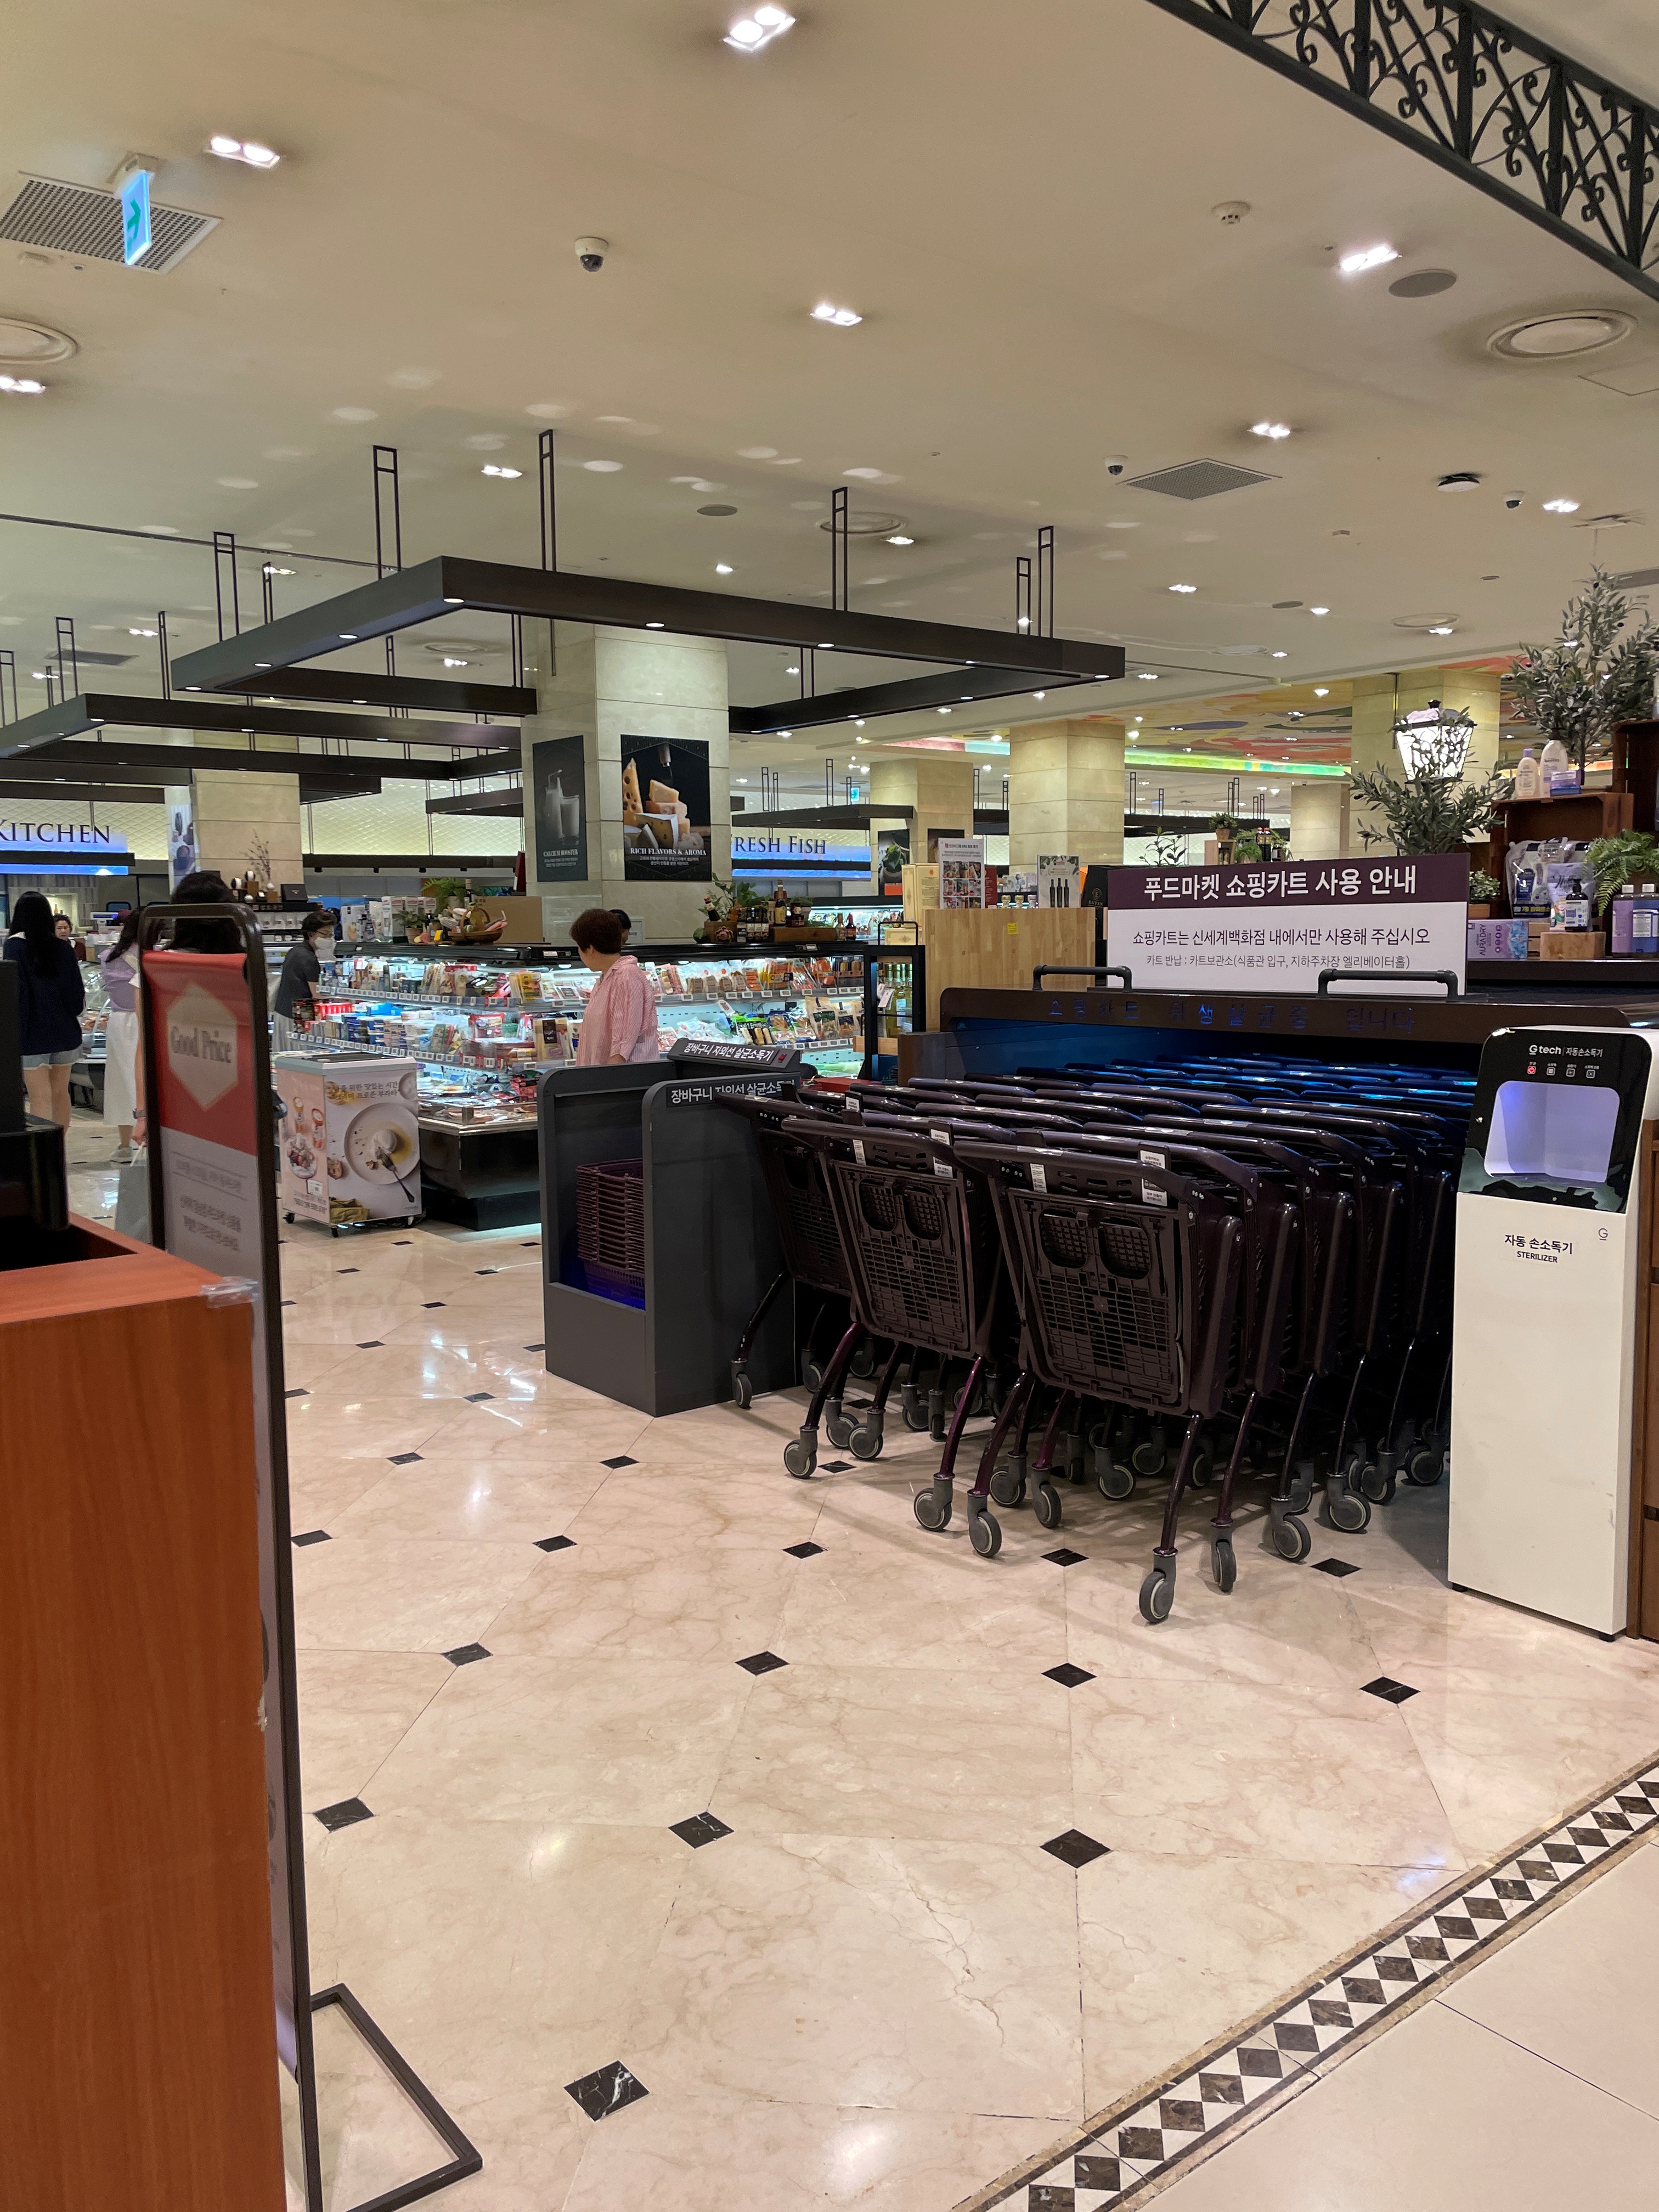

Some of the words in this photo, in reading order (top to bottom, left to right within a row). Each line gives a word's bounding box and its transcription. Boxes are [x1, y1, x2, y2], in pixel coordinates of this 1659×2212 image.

[733, 837, 781, 853] RESH
[1144, 873, 1220, 901] 푸드마켓
[1226, 870, 1309, 899] 쇼핑카트
[1315, 868, 1362, 896] 사용
[1369, 865, 1416, 895] 안내
[1133, 929, 1189, 945] 쇼핑카트는
[1192, 929, 1265, 946] 신세계백화점
[1269, 928, 1322, 945] 내에서만
[1325, 928, 1367, 945] 사용해
[1370, 927, 1430, 945] 주십시오
[1147, 955, 1163, 966] 카트
[1165, 955, 1182, 967] 반납
[1267, 955, 1288, 968] 입구,
[1290, 955, 1340, 968] 지하주차장
[1343, 955, 1410, 969] 엘리베이터홀)
[171, 1025, 199, 1057] Good
[201, 1030, 232, 1063] Price
[684, 1042, 714, 1056] 장바구니
[712, 1045, 737, 1057] 자외선
[733, 1047, 775, 1062] 살균소독기
[1566, 1047, 1603, 1058] 자동손소독기
[671, 1086, 712, 1104] 장바구니
[1504, 1234, 1526, 1248] 자동
[1528, 1238, 1573, 1255] 손소독기
[1516, 1251, 1558, 1263] STERILIZER
